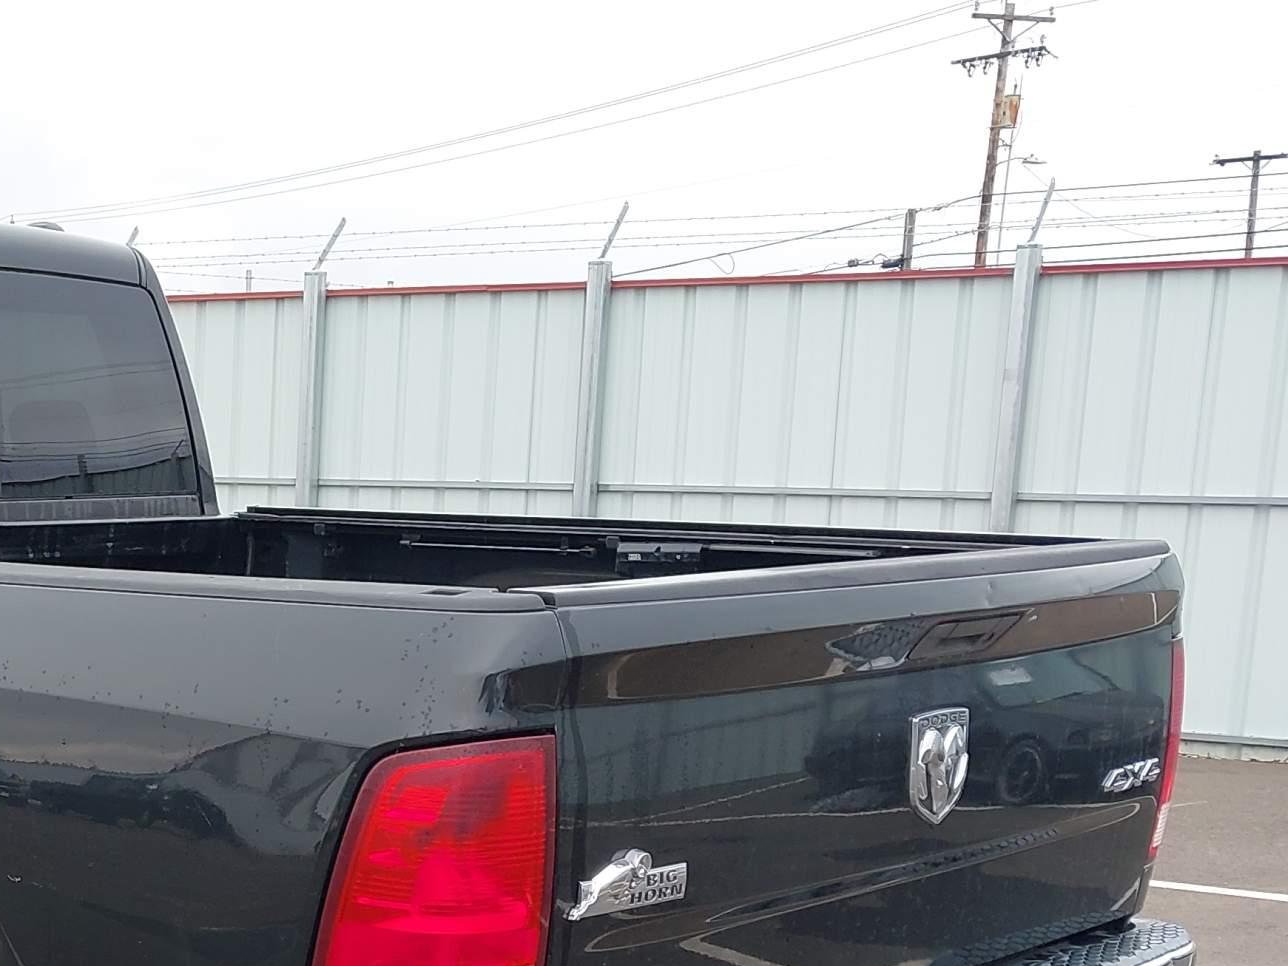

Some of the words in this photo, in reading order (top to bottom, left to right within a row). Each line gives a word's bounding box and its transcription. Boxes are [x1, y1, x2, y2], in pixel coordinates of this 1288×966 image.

[919, 711, 968, 728] DODGE
[646, 869, 678, 887] BIG
[629, 883, 683, 905] HORN
